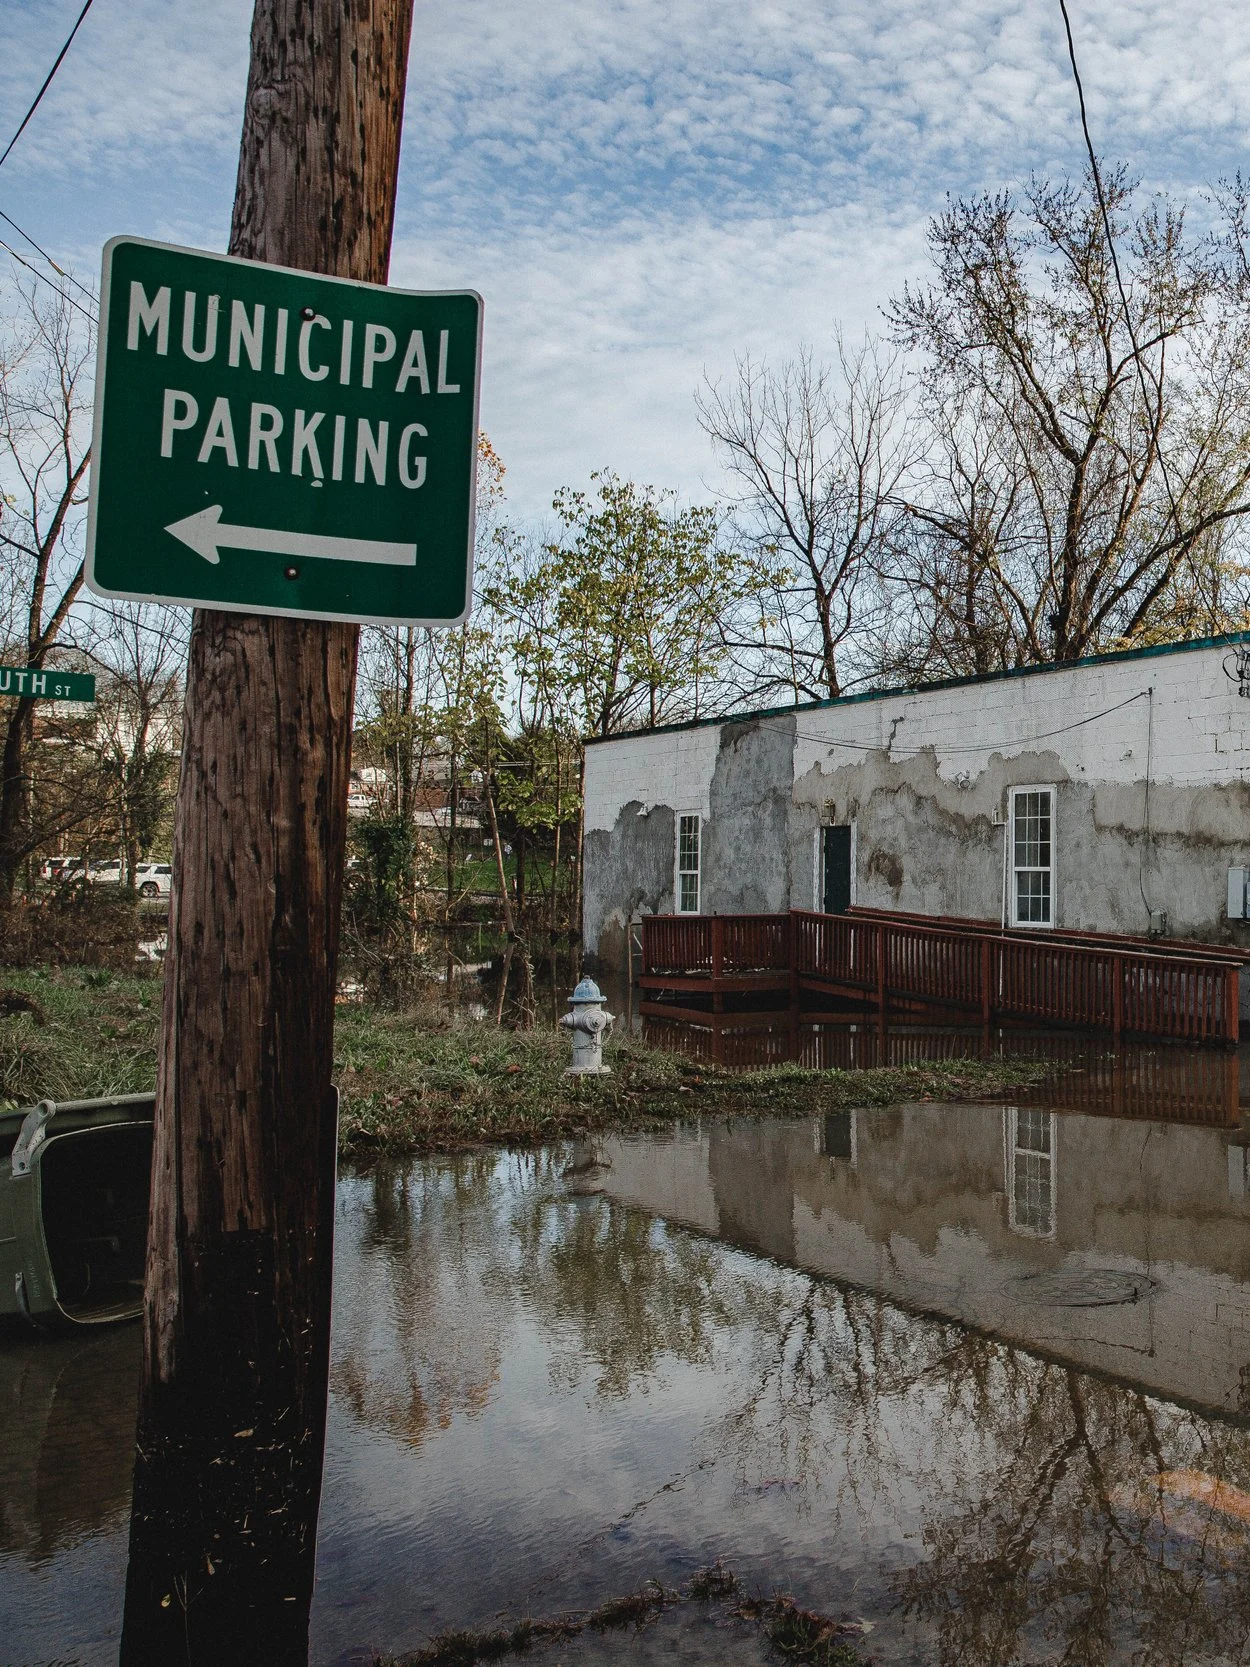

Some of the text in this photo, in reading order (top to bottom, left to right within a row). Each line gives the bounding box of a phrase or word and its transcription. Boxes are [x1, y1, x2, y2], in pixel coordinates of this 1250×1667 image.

[127, 280, 461, 395] MUNICIPAL
[160, 388, 428, 489] PARKING
[54, 685, 71, 697] ST
